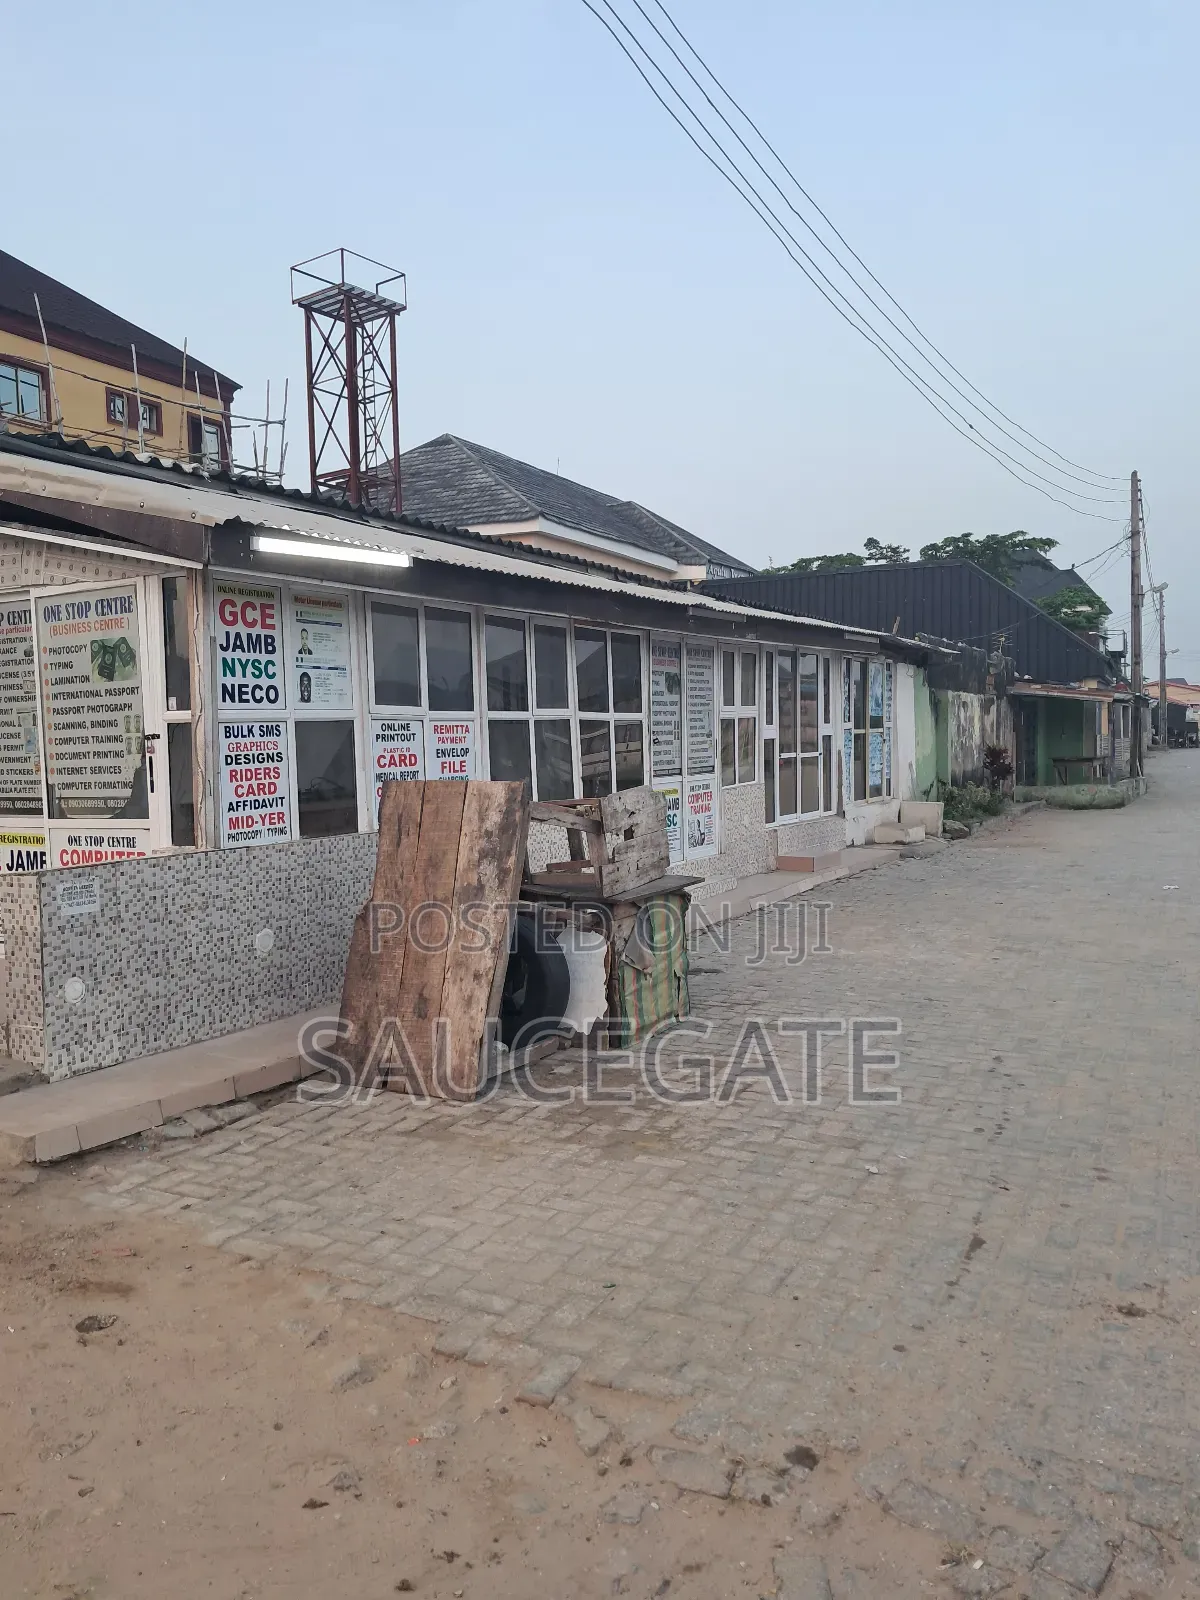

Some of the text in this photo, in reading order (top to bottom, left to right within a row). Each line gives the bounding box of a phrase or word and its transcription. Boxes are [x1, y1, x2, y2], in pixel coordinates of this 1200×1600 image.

[218, 585, 237, 594] ONLINE
[43, 595, 134, 623] ONE STOP CENTRE
[218, 598, 276, 630] GCE
[50, 621, 92, 638] (BUSINESS
[218, 630, 276, 655] JAMB
[48, 644, 88, 656] PHOTOCOPY
[50, 660, 74, 670] TYPING
[222, 656, 277, 680] NYSC
[50, 675, 90, 686] LAMINATION
[52, 686, 140, 701] INTERNATIONAL PASSPORT
[222, 682, 280, 704] NECO
[52, 703, 132, 716] PASSPORT PHOTOGRAPH
[54, 719, 118, 731] SCANNING, BINDING
[224, 724, 281, 739] BULK SMS
[380, 722, 411, 732] ONLINE
[433, 724, 470, 734] REMITTA
[54, 734, 124, 746] COMPUTER TRAINING
[376, 733, 416, 742] PRINTOUT
[438, 736, 467, 744] PAYMENT
[228, 741, 279, 752] GRAPHICS
[436, 747, 470, 758] ENVELOP
[55, 750, 124, 761] DOCUMENT PRINTING
[225, 752, 283, 766] DESIGNS
[376, 753, 418, 768] CARD
[56, 766, 122, 775] INTERNET SERVICES
[440, 760, 467, 774] FILE
[229, 766, 280, 783] RIDERS
[376, 770, 420, 783] MEDICAL REPORT
[58, 781, 133, 790] COMPUTER FORMATING
[234, 782, 277, 798] CARD
[228, 796, 285, 813] AFFIDAVIT
[688, 791, 712, 805] COMPUTER
[691, 803, 711, 815] TRAINING
[228, 811, 286, 831] MID-YER
[228, 828, 262, 843] PHOTOCOPY
[267, 826, 287, 838] TYPING
[68, 835, 137, 848] ONE STOP CENTRE
